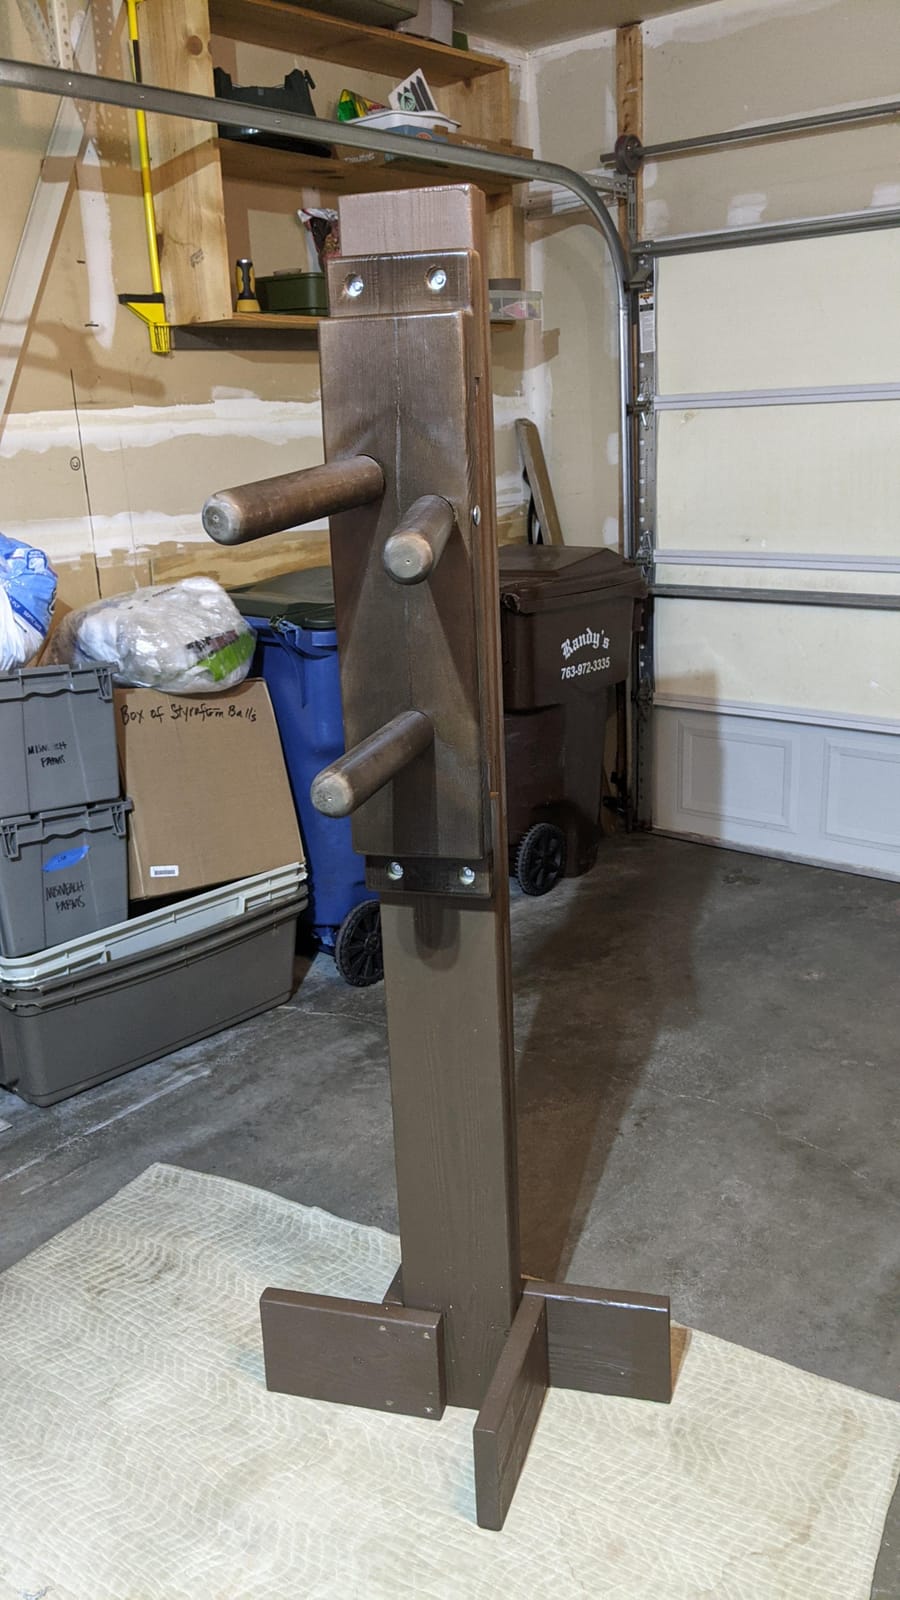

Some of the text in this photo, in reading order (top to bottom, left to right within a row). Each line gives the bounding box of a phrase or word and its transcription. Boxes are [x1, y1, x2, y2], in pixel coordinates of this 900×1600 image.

[561, 627, 610, 660] Randy's
[561, 657, 610, 680] 763-972-3335
[120, 704, 144, 726] Box
[150, 705, 164, 724] of
[228, 704, 256, 722] Balls
